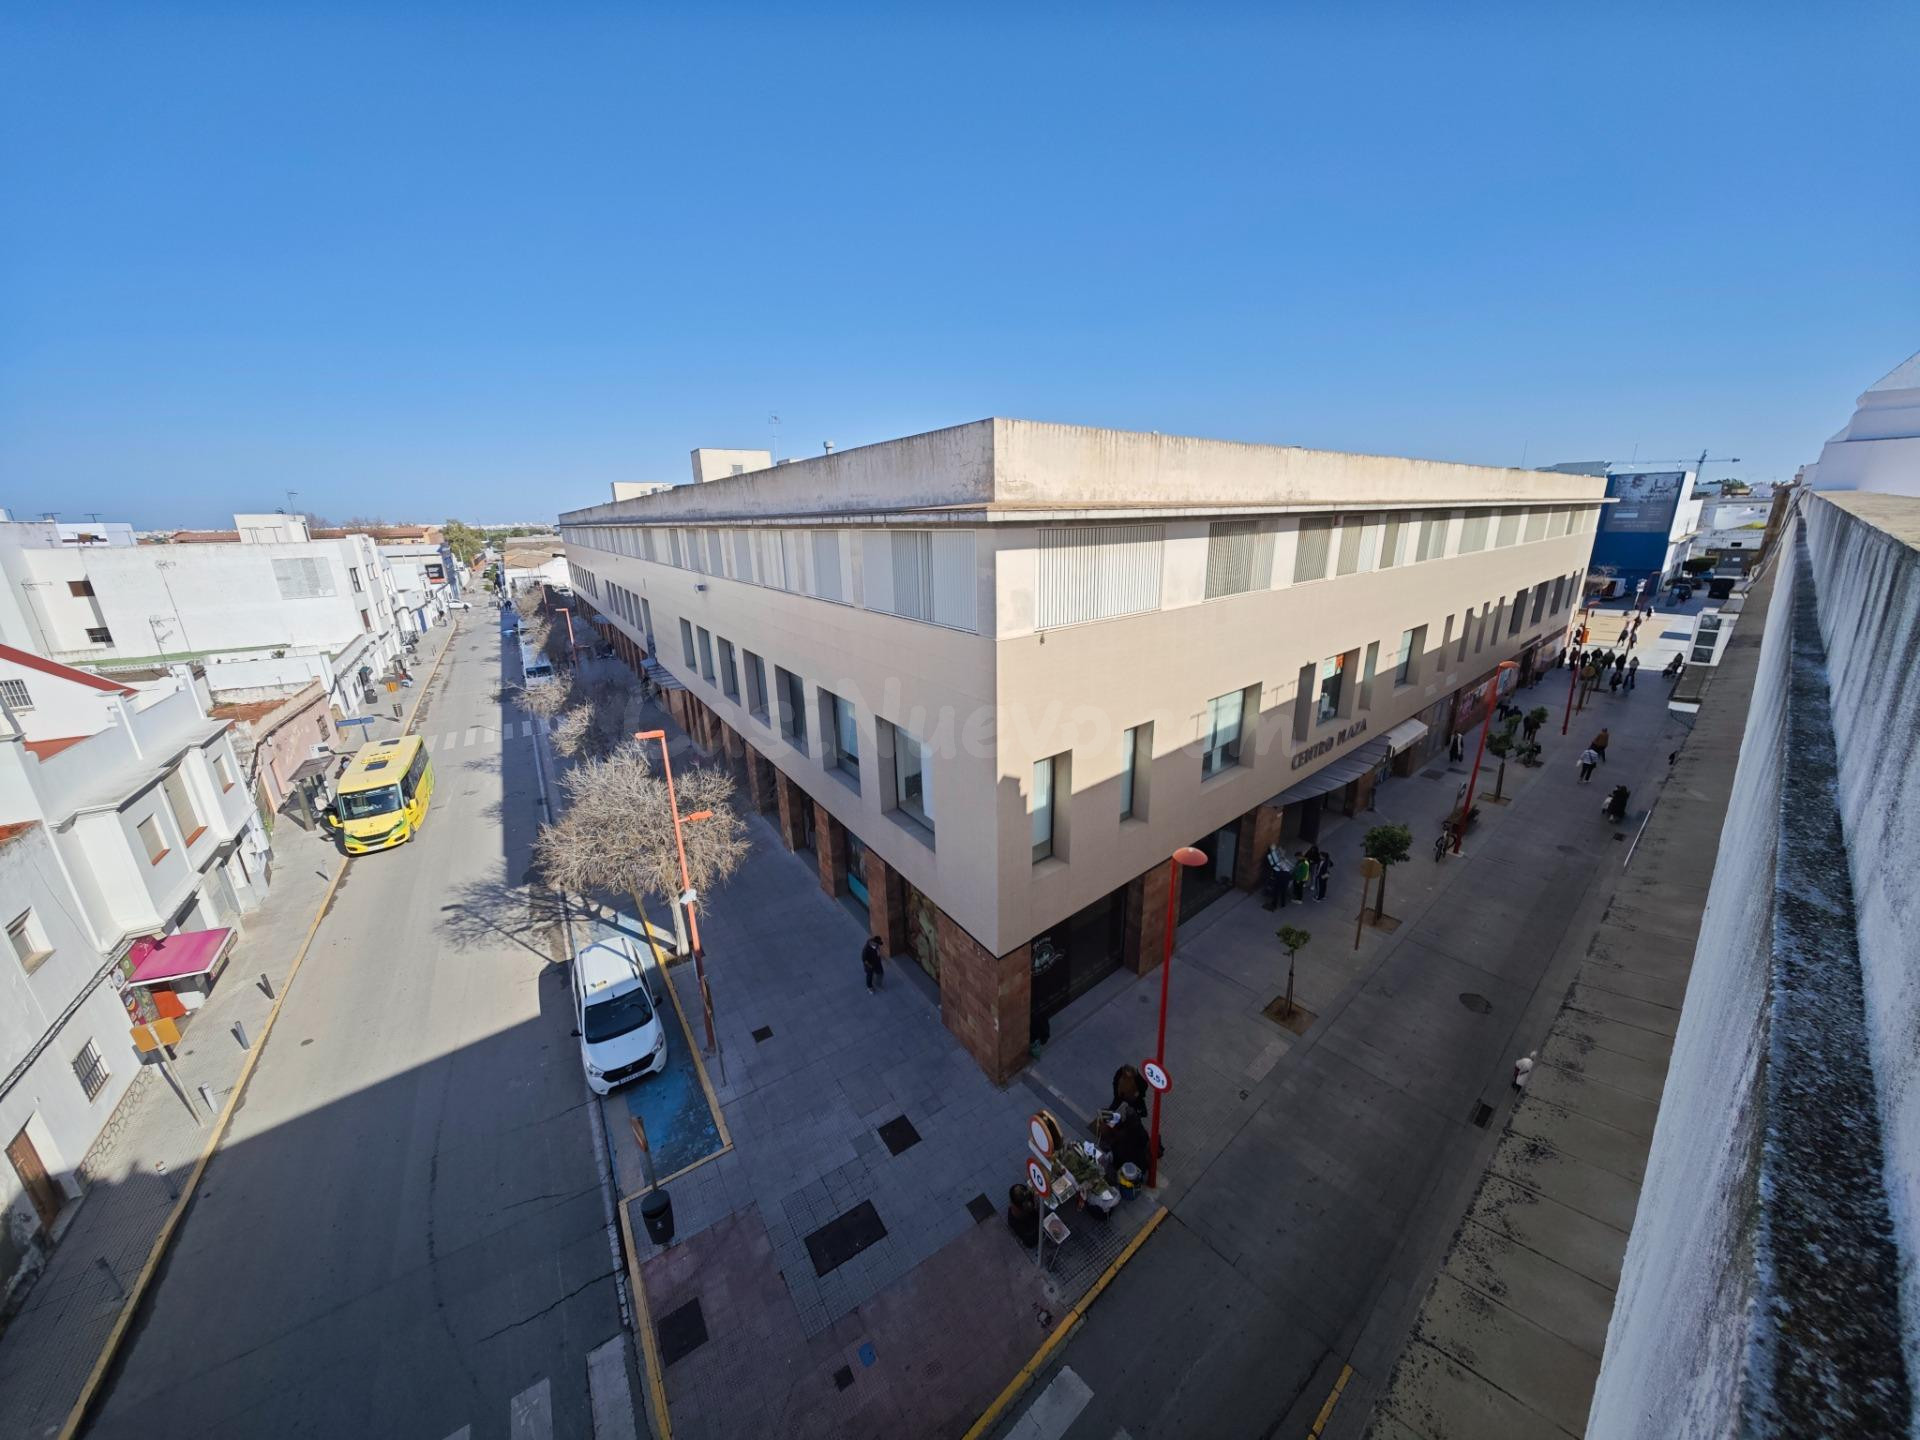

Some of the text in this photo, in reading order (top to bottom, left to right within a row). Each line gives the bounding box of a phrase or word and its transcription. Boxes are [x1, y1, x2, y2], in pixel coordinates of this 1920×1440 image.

[1291, 718, 1368, 770] CENTRO PLAZA
[1032, 1168, 1043, 1187] 10
